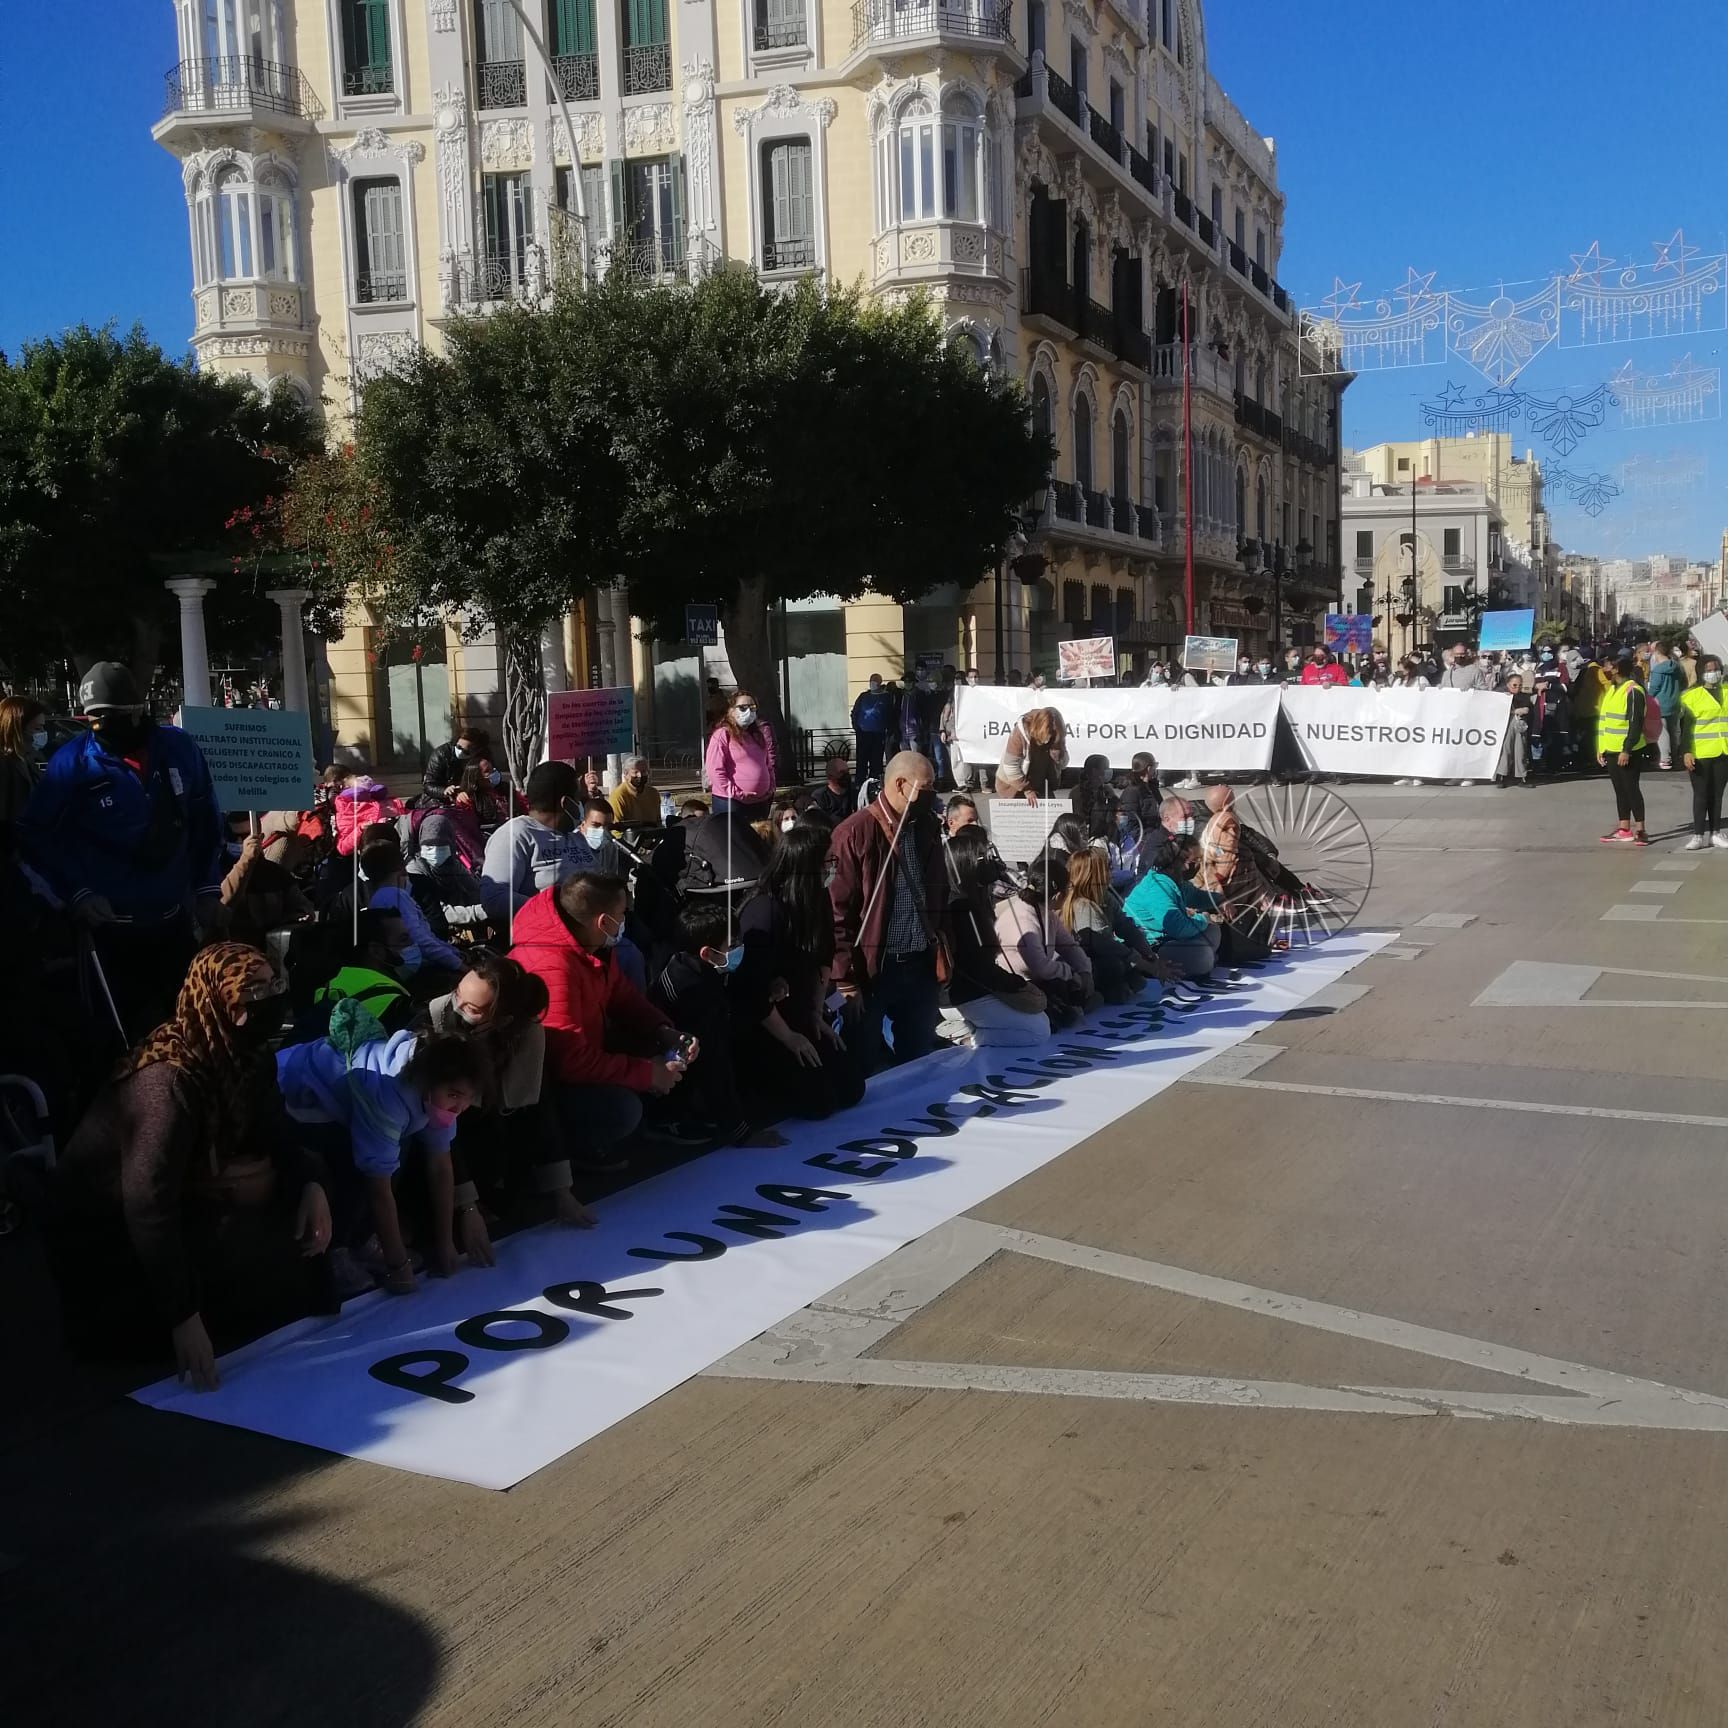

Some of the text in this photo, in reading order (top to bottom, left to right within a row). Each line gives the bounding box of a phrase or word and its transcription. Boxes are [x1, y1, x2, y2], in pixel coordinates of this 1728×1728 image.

[689, 618, 716, 632] TAXI
[224, 723, 268, 733] SUFRIMOS
[1087, 723, 1128, 740] POR
[1133, 724, 1160, 740] LA
[1164, 721, 1268, 741] DIGNIDAD
[1306, 723, 1426, 744] NUESTROS
[1431, 727, 1498, 746] HIJOS
[240, 736, 303, 747] INSTITUCIONAL
[250, 748, 257, 757] Y
[295, 750, 302, 759] A
[208, 759, 300, 771] ÑOS DISCAPACITADOS
[213, 773, 302, 785] todos los colegios de
[238, 786, 268, 796] Melilla
[367, 1280, 665, 1405] POR
[626, 1183, 853, 1263] UNA
